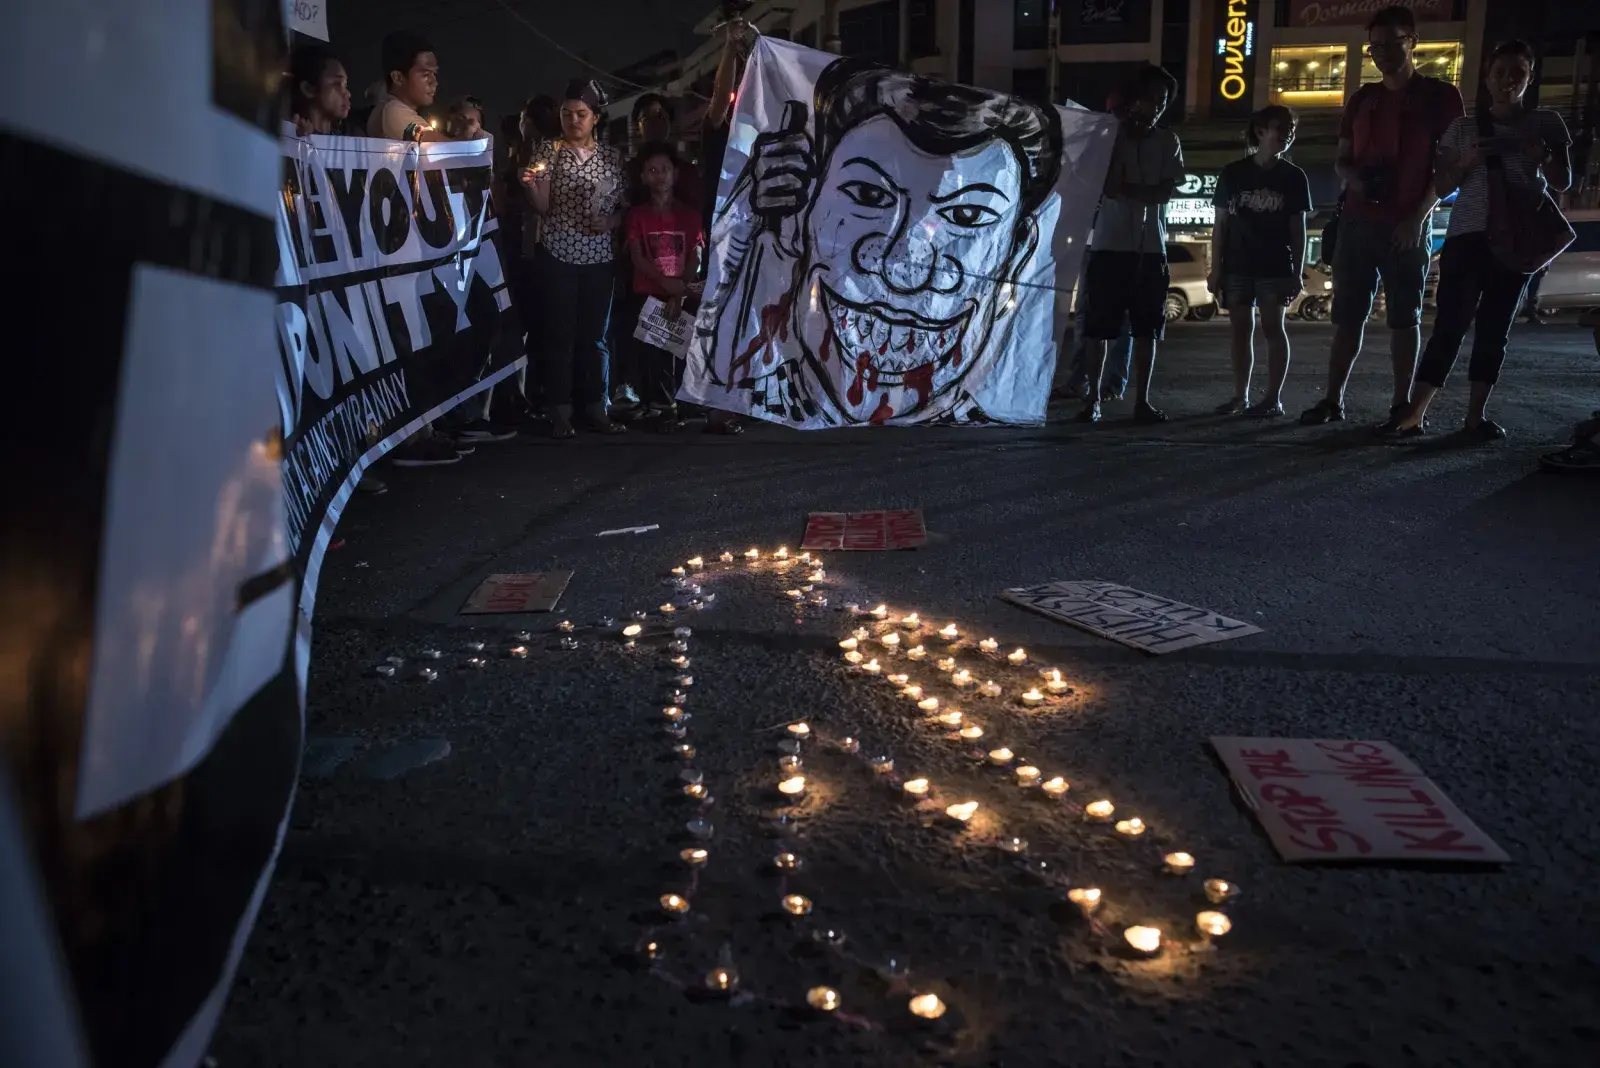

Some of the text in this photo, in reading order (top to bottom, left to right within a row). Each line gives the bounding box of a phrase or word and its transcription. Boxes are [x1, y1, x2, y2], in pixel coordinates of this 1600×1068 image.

[1218, 38, 1231, 54] THE
[1168, 216, 1192, 224] SHOP
[1169, 200, 1191, 209] THE
[290, 409, 343, 514] AGAINST
[335, 367, 410, 456] TYRANNY
[1240, 748, 1371, 853] STOP THE
[1316, 741, 1484, 852] KILLINGS
